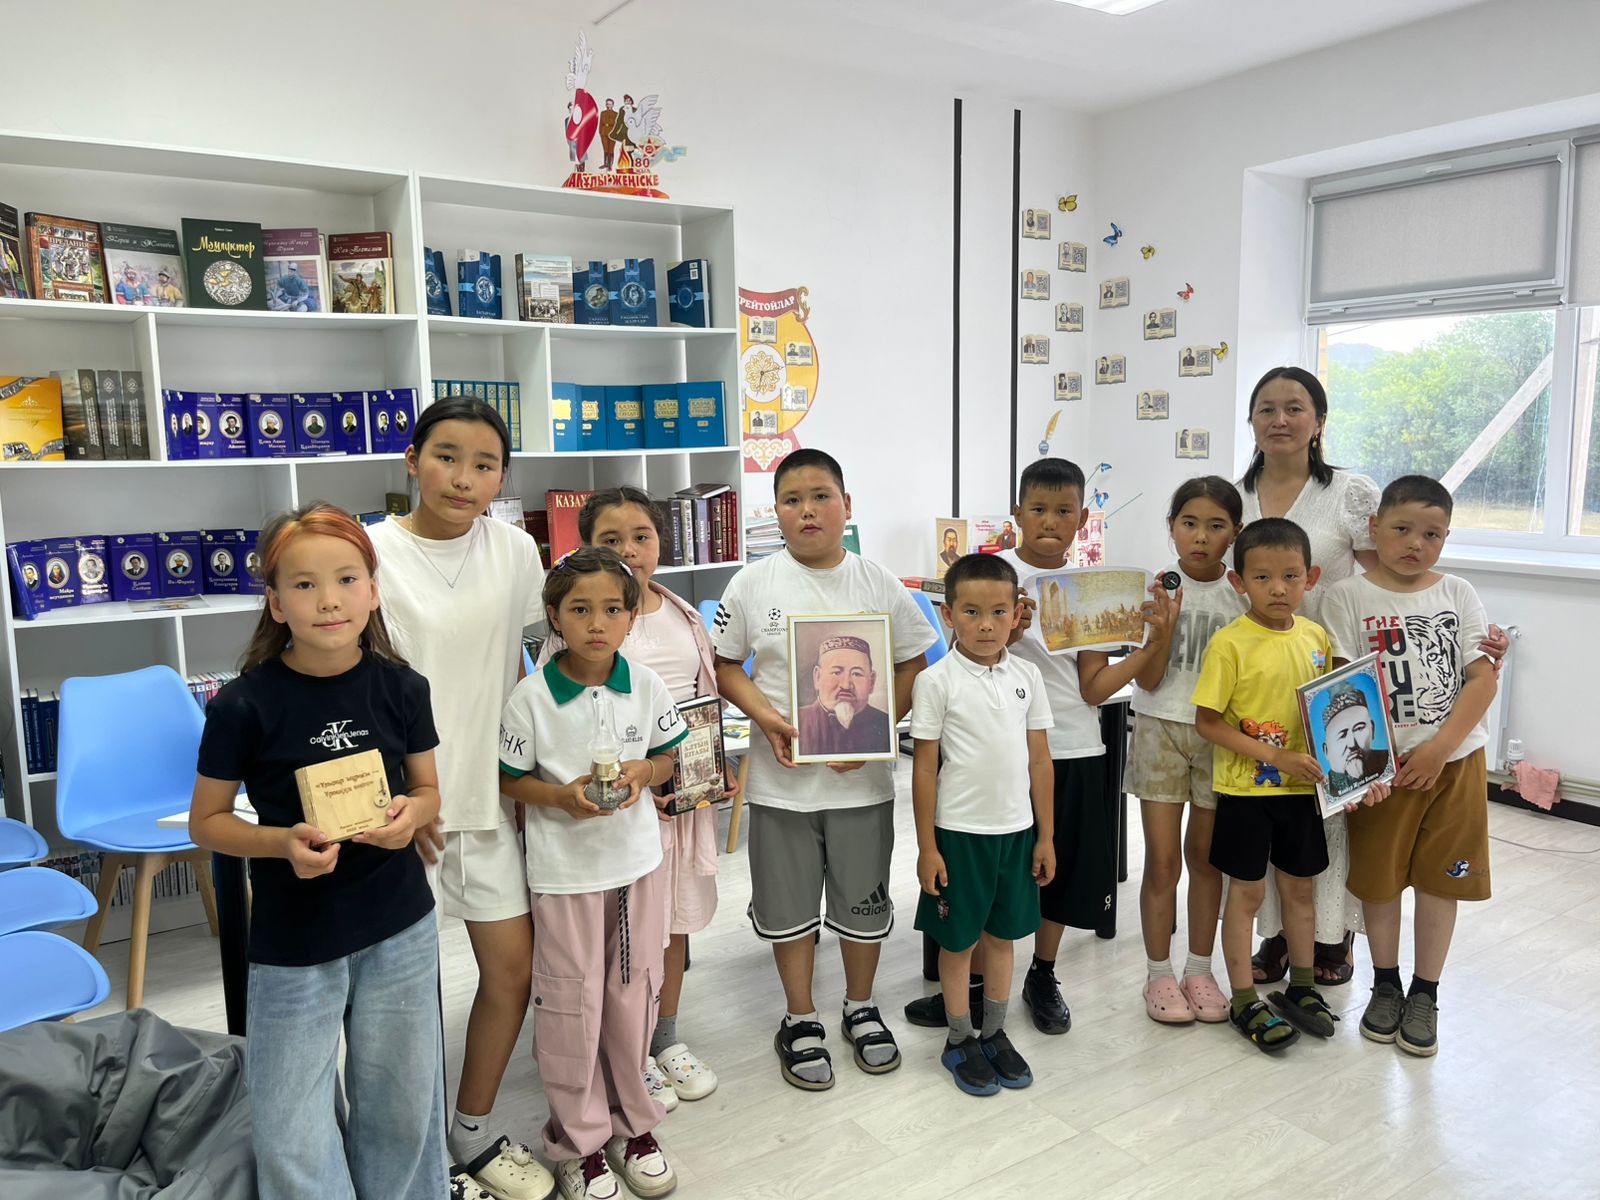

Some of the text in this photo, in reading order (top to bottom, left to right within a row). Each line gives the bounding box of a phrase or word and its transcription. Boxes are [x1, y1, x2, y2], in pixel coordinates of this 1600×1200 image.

[635, 157, 650, 168] 80
[739, 295, 795, 311] РЕЙТОЙЛАР
[555, 494, 590, 508] КАЗАХ
[1362, 615, 1400, 631] THE
